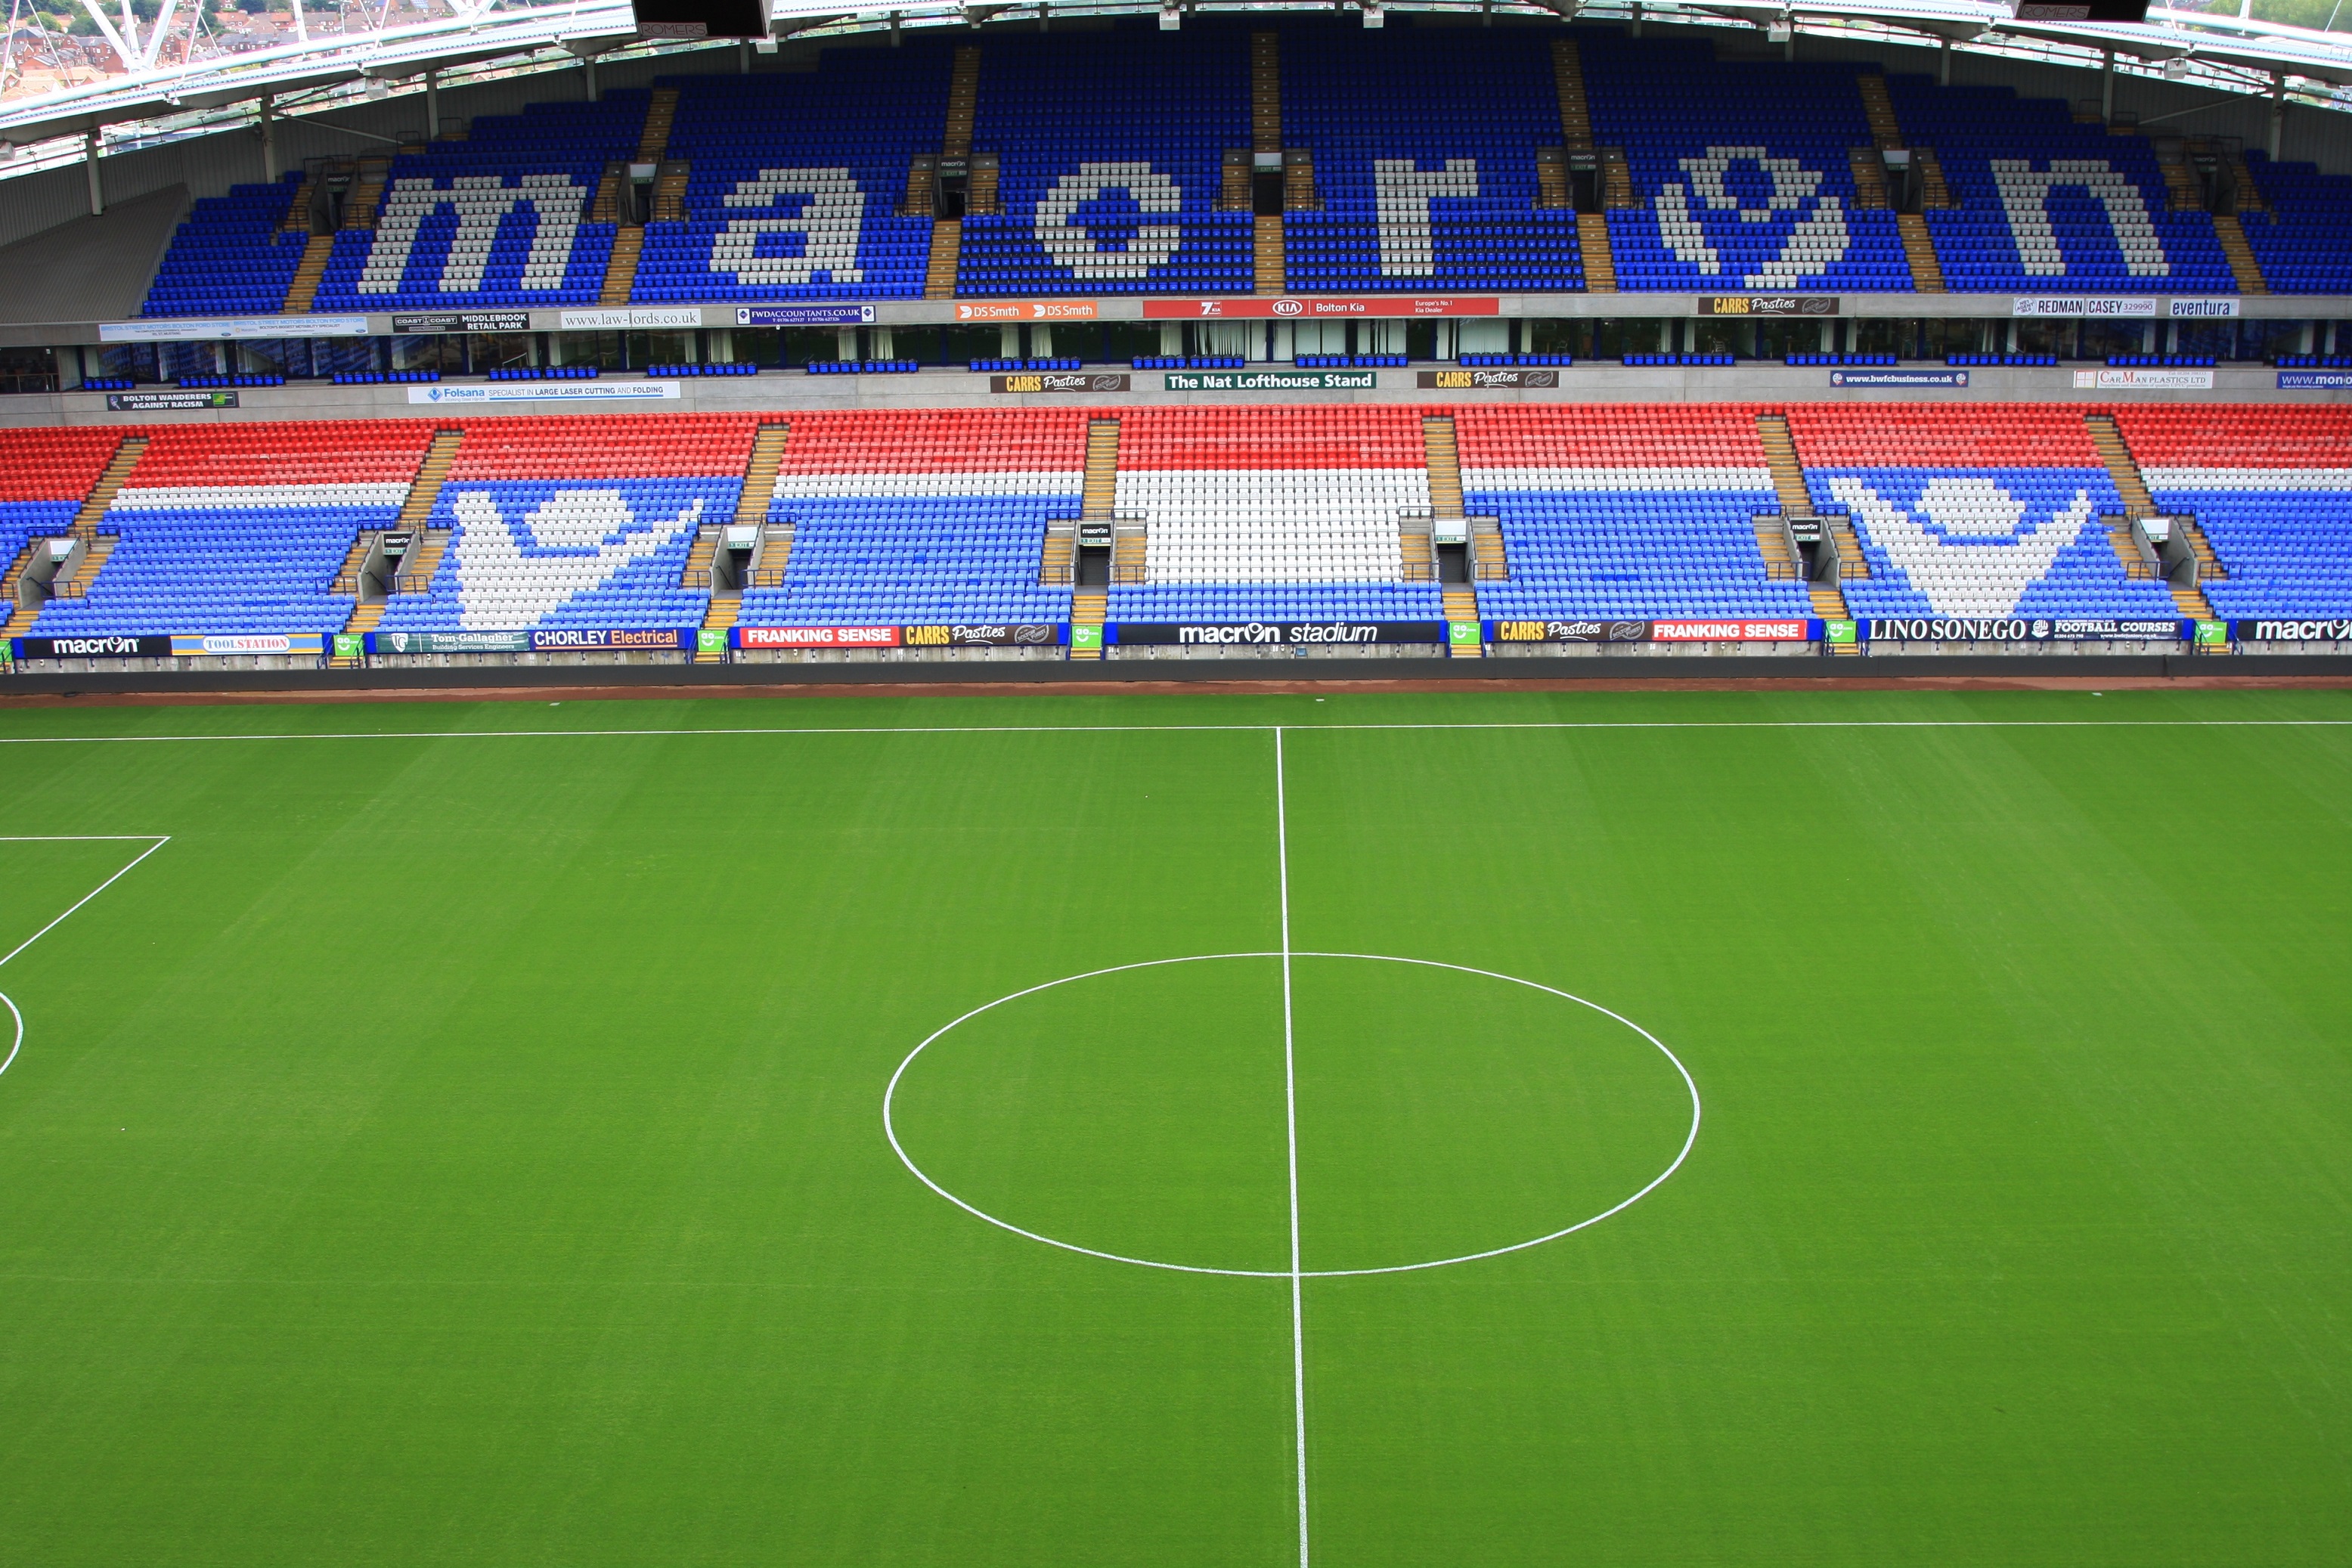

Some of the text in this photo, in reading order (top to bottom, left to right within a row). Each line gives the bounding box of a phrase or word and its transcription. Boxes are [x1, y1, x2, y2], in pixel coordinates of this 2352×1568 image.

[2022, 5, 2087, 19] ROMERS
[640, 23, 706, 36] ROMERS
[974, 305, 1019, 317] DS Smith
[1047, 305, 1093, 316] DS Smith
[1201, 302, 1213, 315] 7
[1278, 303, 1297, 312] KIA
[1315, 302, 1365, 312] Bolton Kia
[1713, 297, 1749, 314] CARRS
[1751, 297, 1796, 311] Pasties
[2037, 300, 2083, 314] REDMAN
[2087, 300, 2123, 314] CASEY
[2172, 299, 2230, 315] eventura
[461, 314, 527, 323] MIDDLEBROOK
[566, 311, 697, 326] www.law-lords.co.uk
[751, 308, 860, 318] FWDACCOUNTANTS.CO.UK
[467, 321, 523, 330] RETAIL PARK
[1006, 375, 1041, 392] CARRS
[1043, 375, 1086, 388] Pasties
[1169, 373, 1372, 389] The Nat Lofthouse Stand
[1436, 371, 1472, 388] CARRS
[1474, 370, 1518, 384] Pasties
[1845, 374, 1953, 383] www.bwfcbusiness.co.uk
[158, 393, 212, 401] WANDERERS
[444, 388, 485, 398] Folsana
[1179, 622, 1377, 643] macron stadium
[1501, 621, 1545, 640] CARRS
[1548, 621, 1602, 636] Pasties
[1653, 624, 1740, 637] FRANKING
[1744, 624, 1799, 637] SENSE
[1869, 619, 2027, 640] LINO SONEGO
[2054, 622, 2175, 633] FOOTBALL COURSES
[2255, 619, 2352, 640] macro
[431, 633, 514, 645] Tom Gallagher
[534, 629, 678, 645] CHORLEY Electrical
[748, 628, 892, 643] FRANKING SENSE
[906, 625, 950, 645] CARRS
[952, 624, 1006, 640] Pasties
[53, 636, 138, 654] macron
[206, 638, 288, 649] TOOLSTATION
